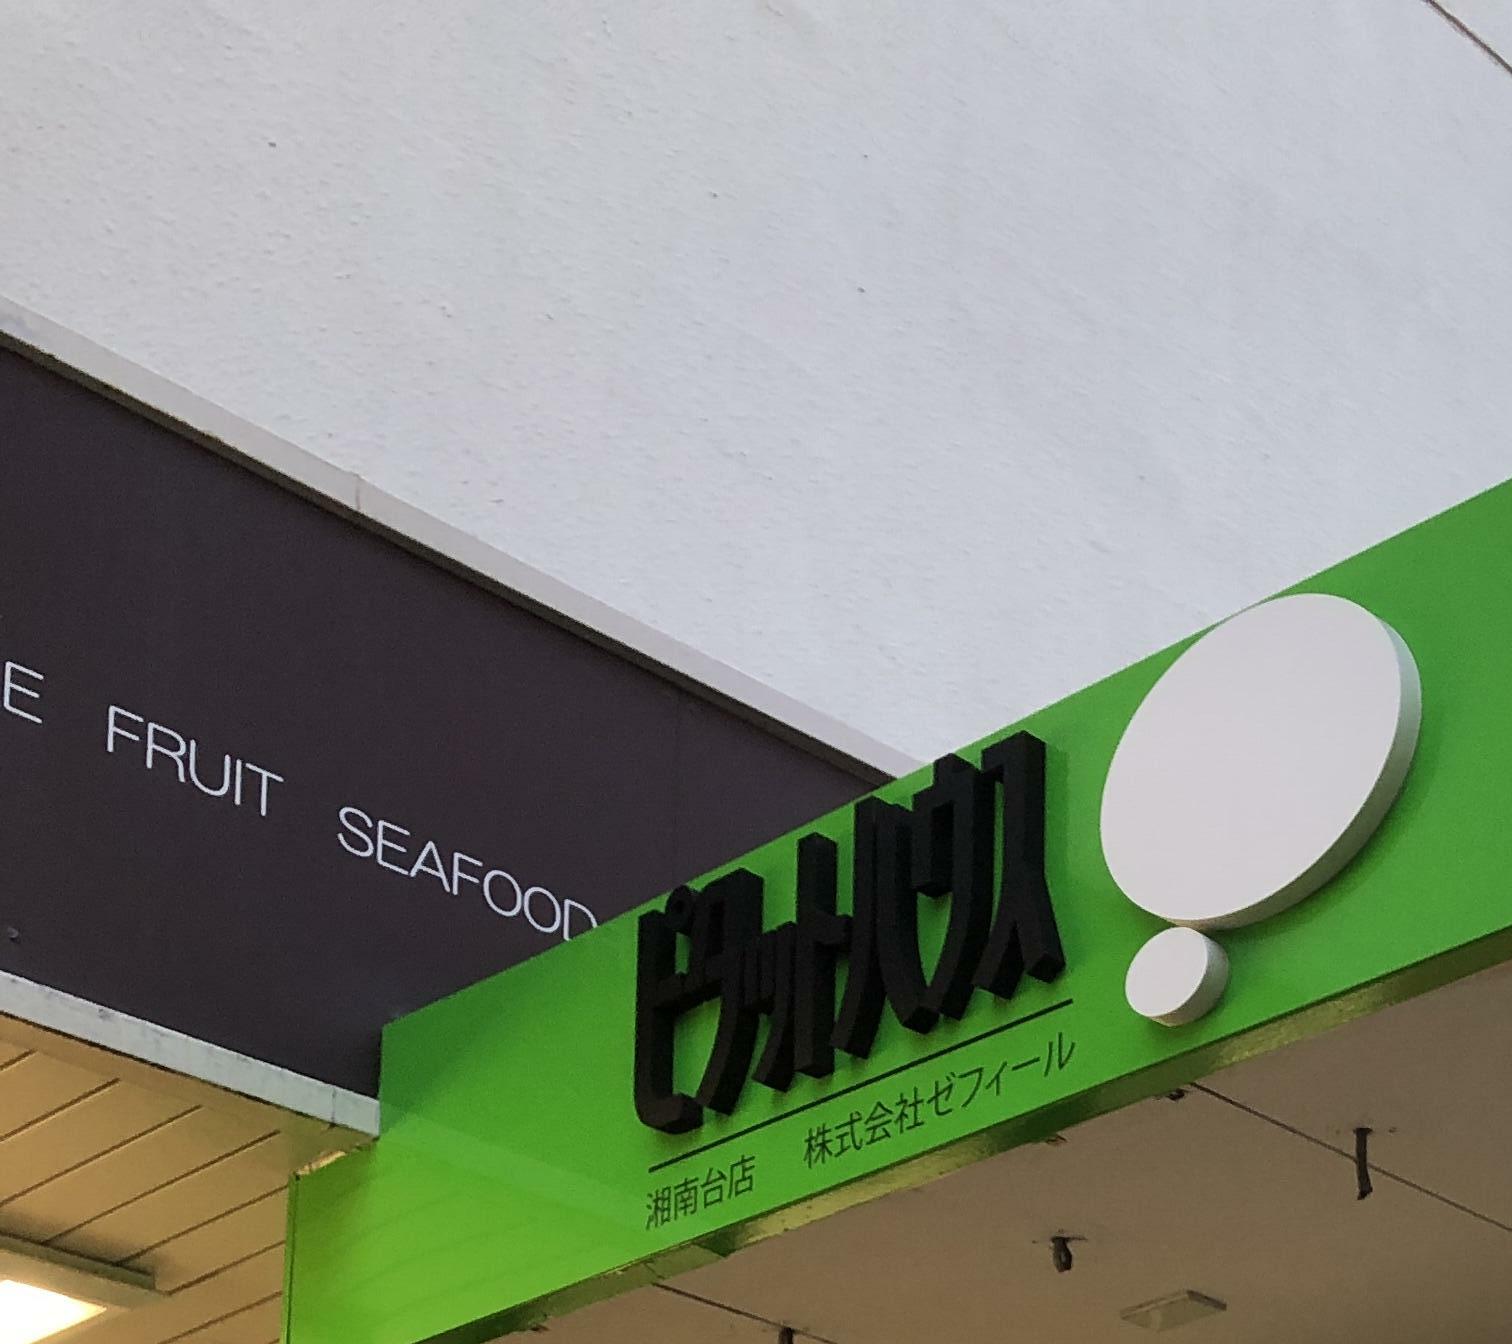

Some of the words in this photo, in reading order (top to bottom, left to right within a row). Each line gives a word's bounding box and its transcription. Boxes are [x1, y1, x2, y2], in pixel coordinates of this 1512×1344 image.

[106, 705, 285, 817] FRUIT
[337, 806, 598, 941] SEAFOOD
[634, 730, 1066, 1135] ピタットハウス
[645, 1154, 757, 1231] 湘南台店
[803, 1031, 1077, 1169] 株式会社ゼフィール
